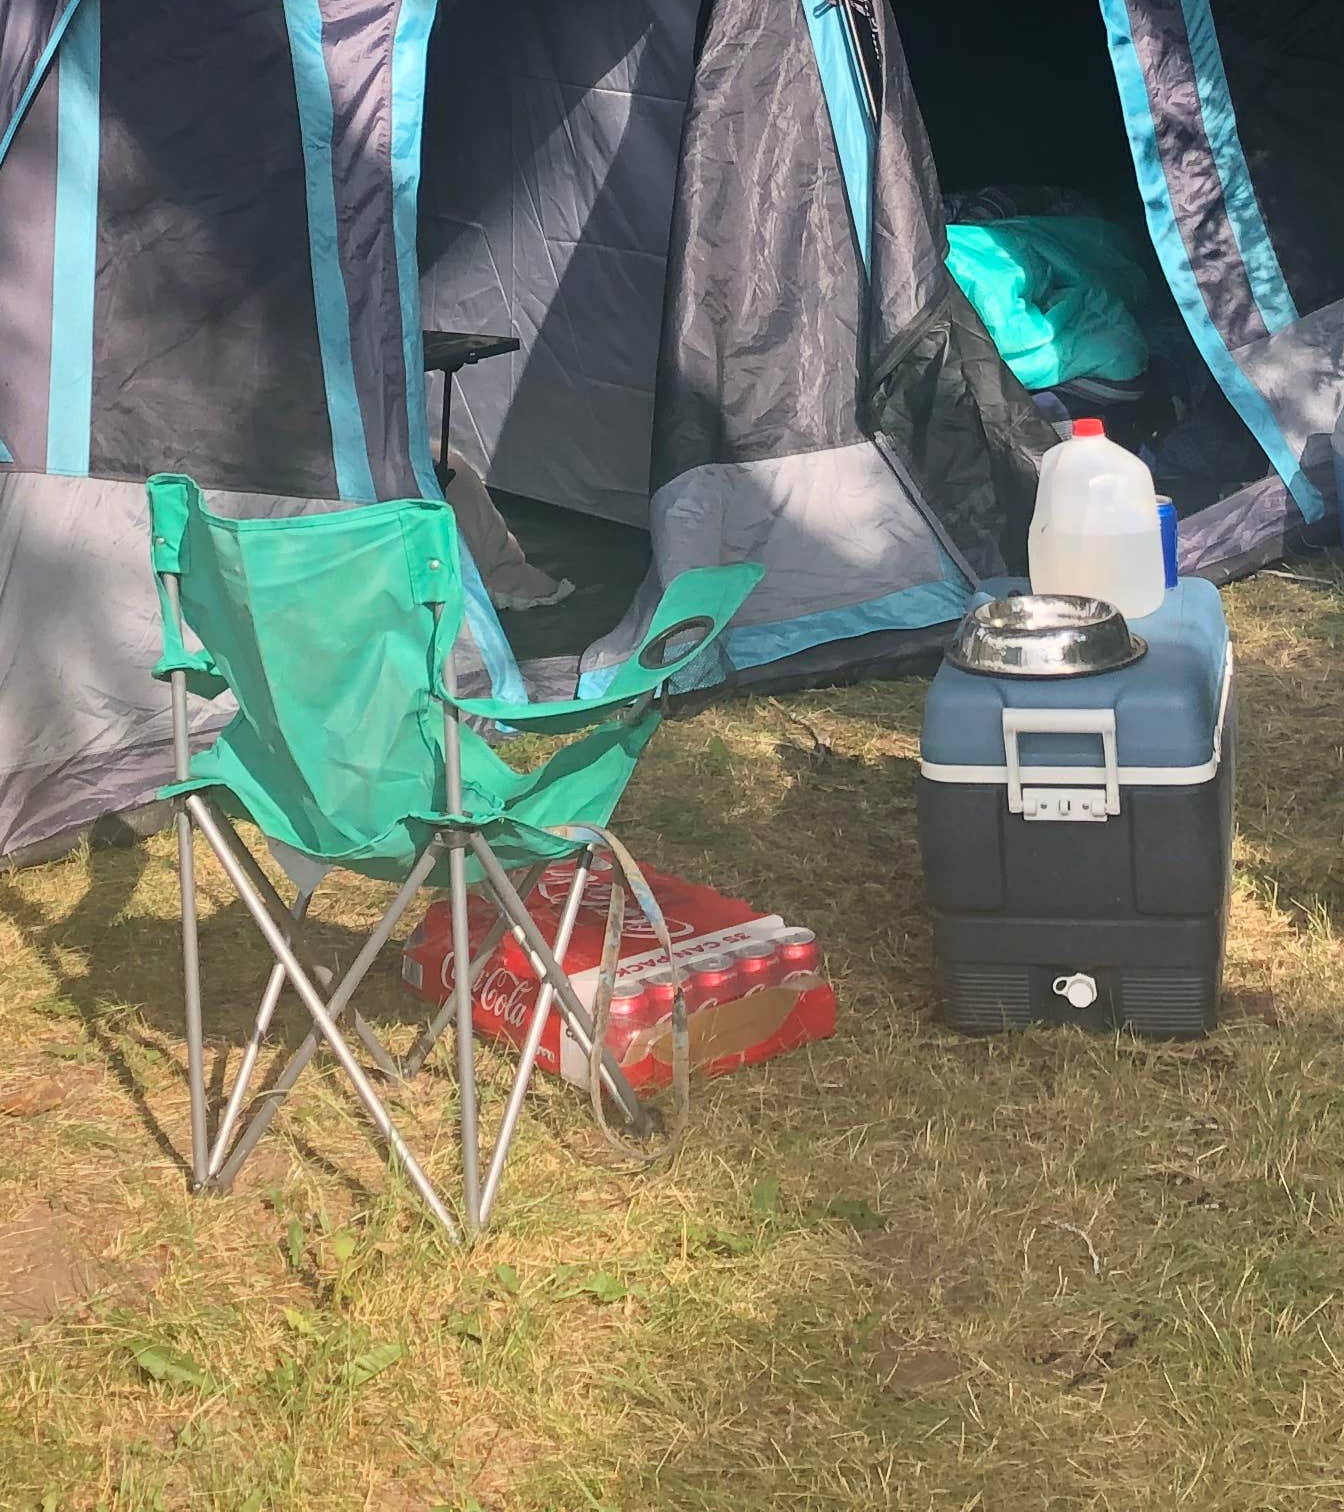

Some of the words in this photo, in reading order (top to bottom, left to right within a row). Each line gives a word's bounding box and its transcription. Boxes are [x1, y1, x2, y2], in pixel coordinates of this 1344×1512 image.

[722, 932, 752, 944] 35
[672, 941, 721, 958] CAN
[616, 955, 672, 977] PACK
